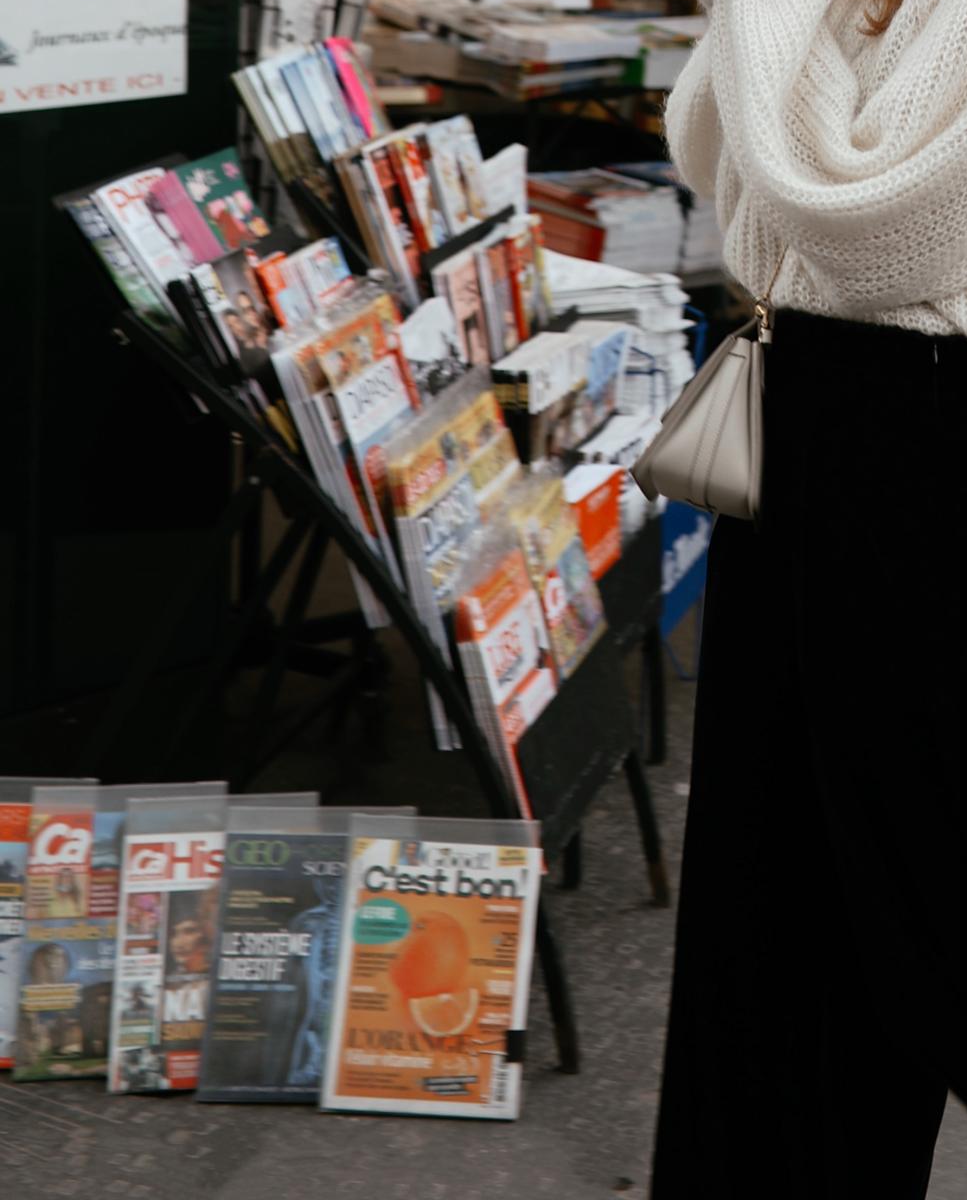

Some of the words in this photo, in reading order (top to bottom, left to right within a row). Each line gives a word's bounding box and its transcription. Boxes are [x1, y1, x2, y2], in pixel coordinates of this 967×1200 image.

[13, 77, 115, 102] VENTE
[126, 73, 165, 90] ICI
[364, 864, 448, 896] C'est
